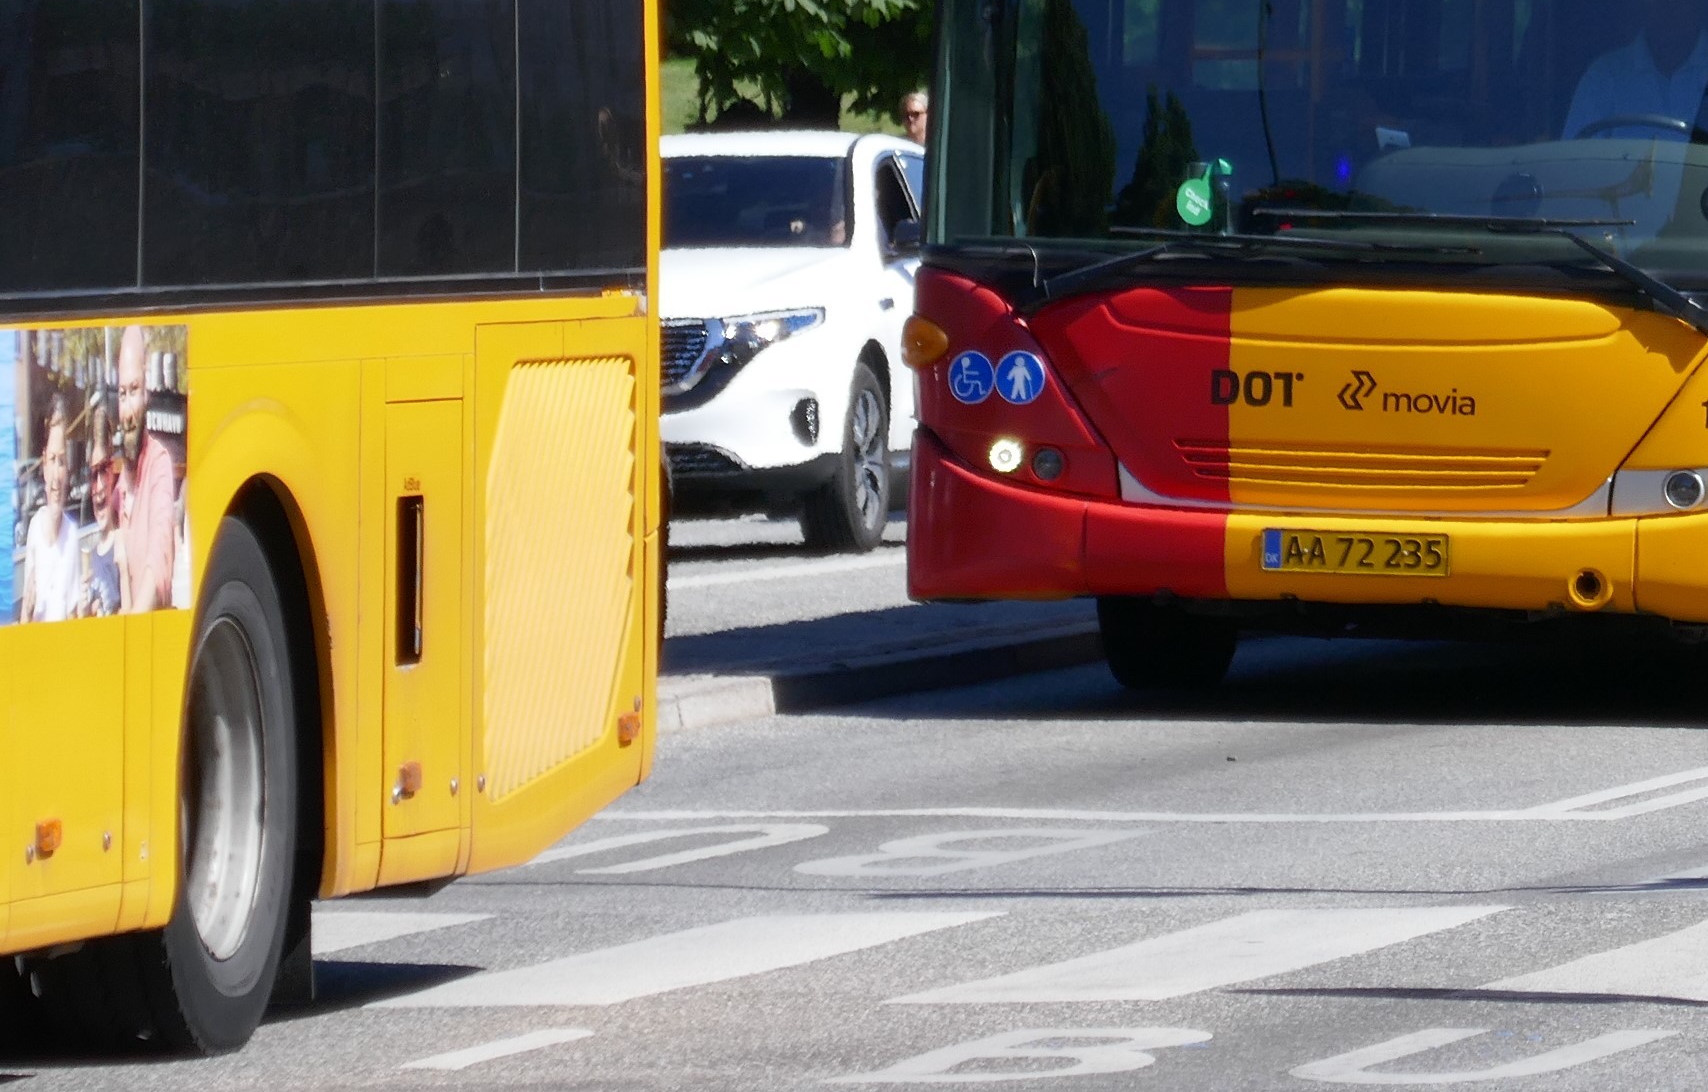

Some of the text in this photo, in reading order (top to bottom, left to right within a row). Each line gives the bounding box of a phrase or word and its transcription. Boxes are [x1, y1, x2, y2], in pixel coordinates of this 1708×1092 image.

[1211, 369, 1304, 407] DOT
[1383, 389, 1476, 415] movia
[1286, 534, 1327, 567] AA
[1336, 537, 1375, 568] 72
[1384, 538, 1442, 570] 235
